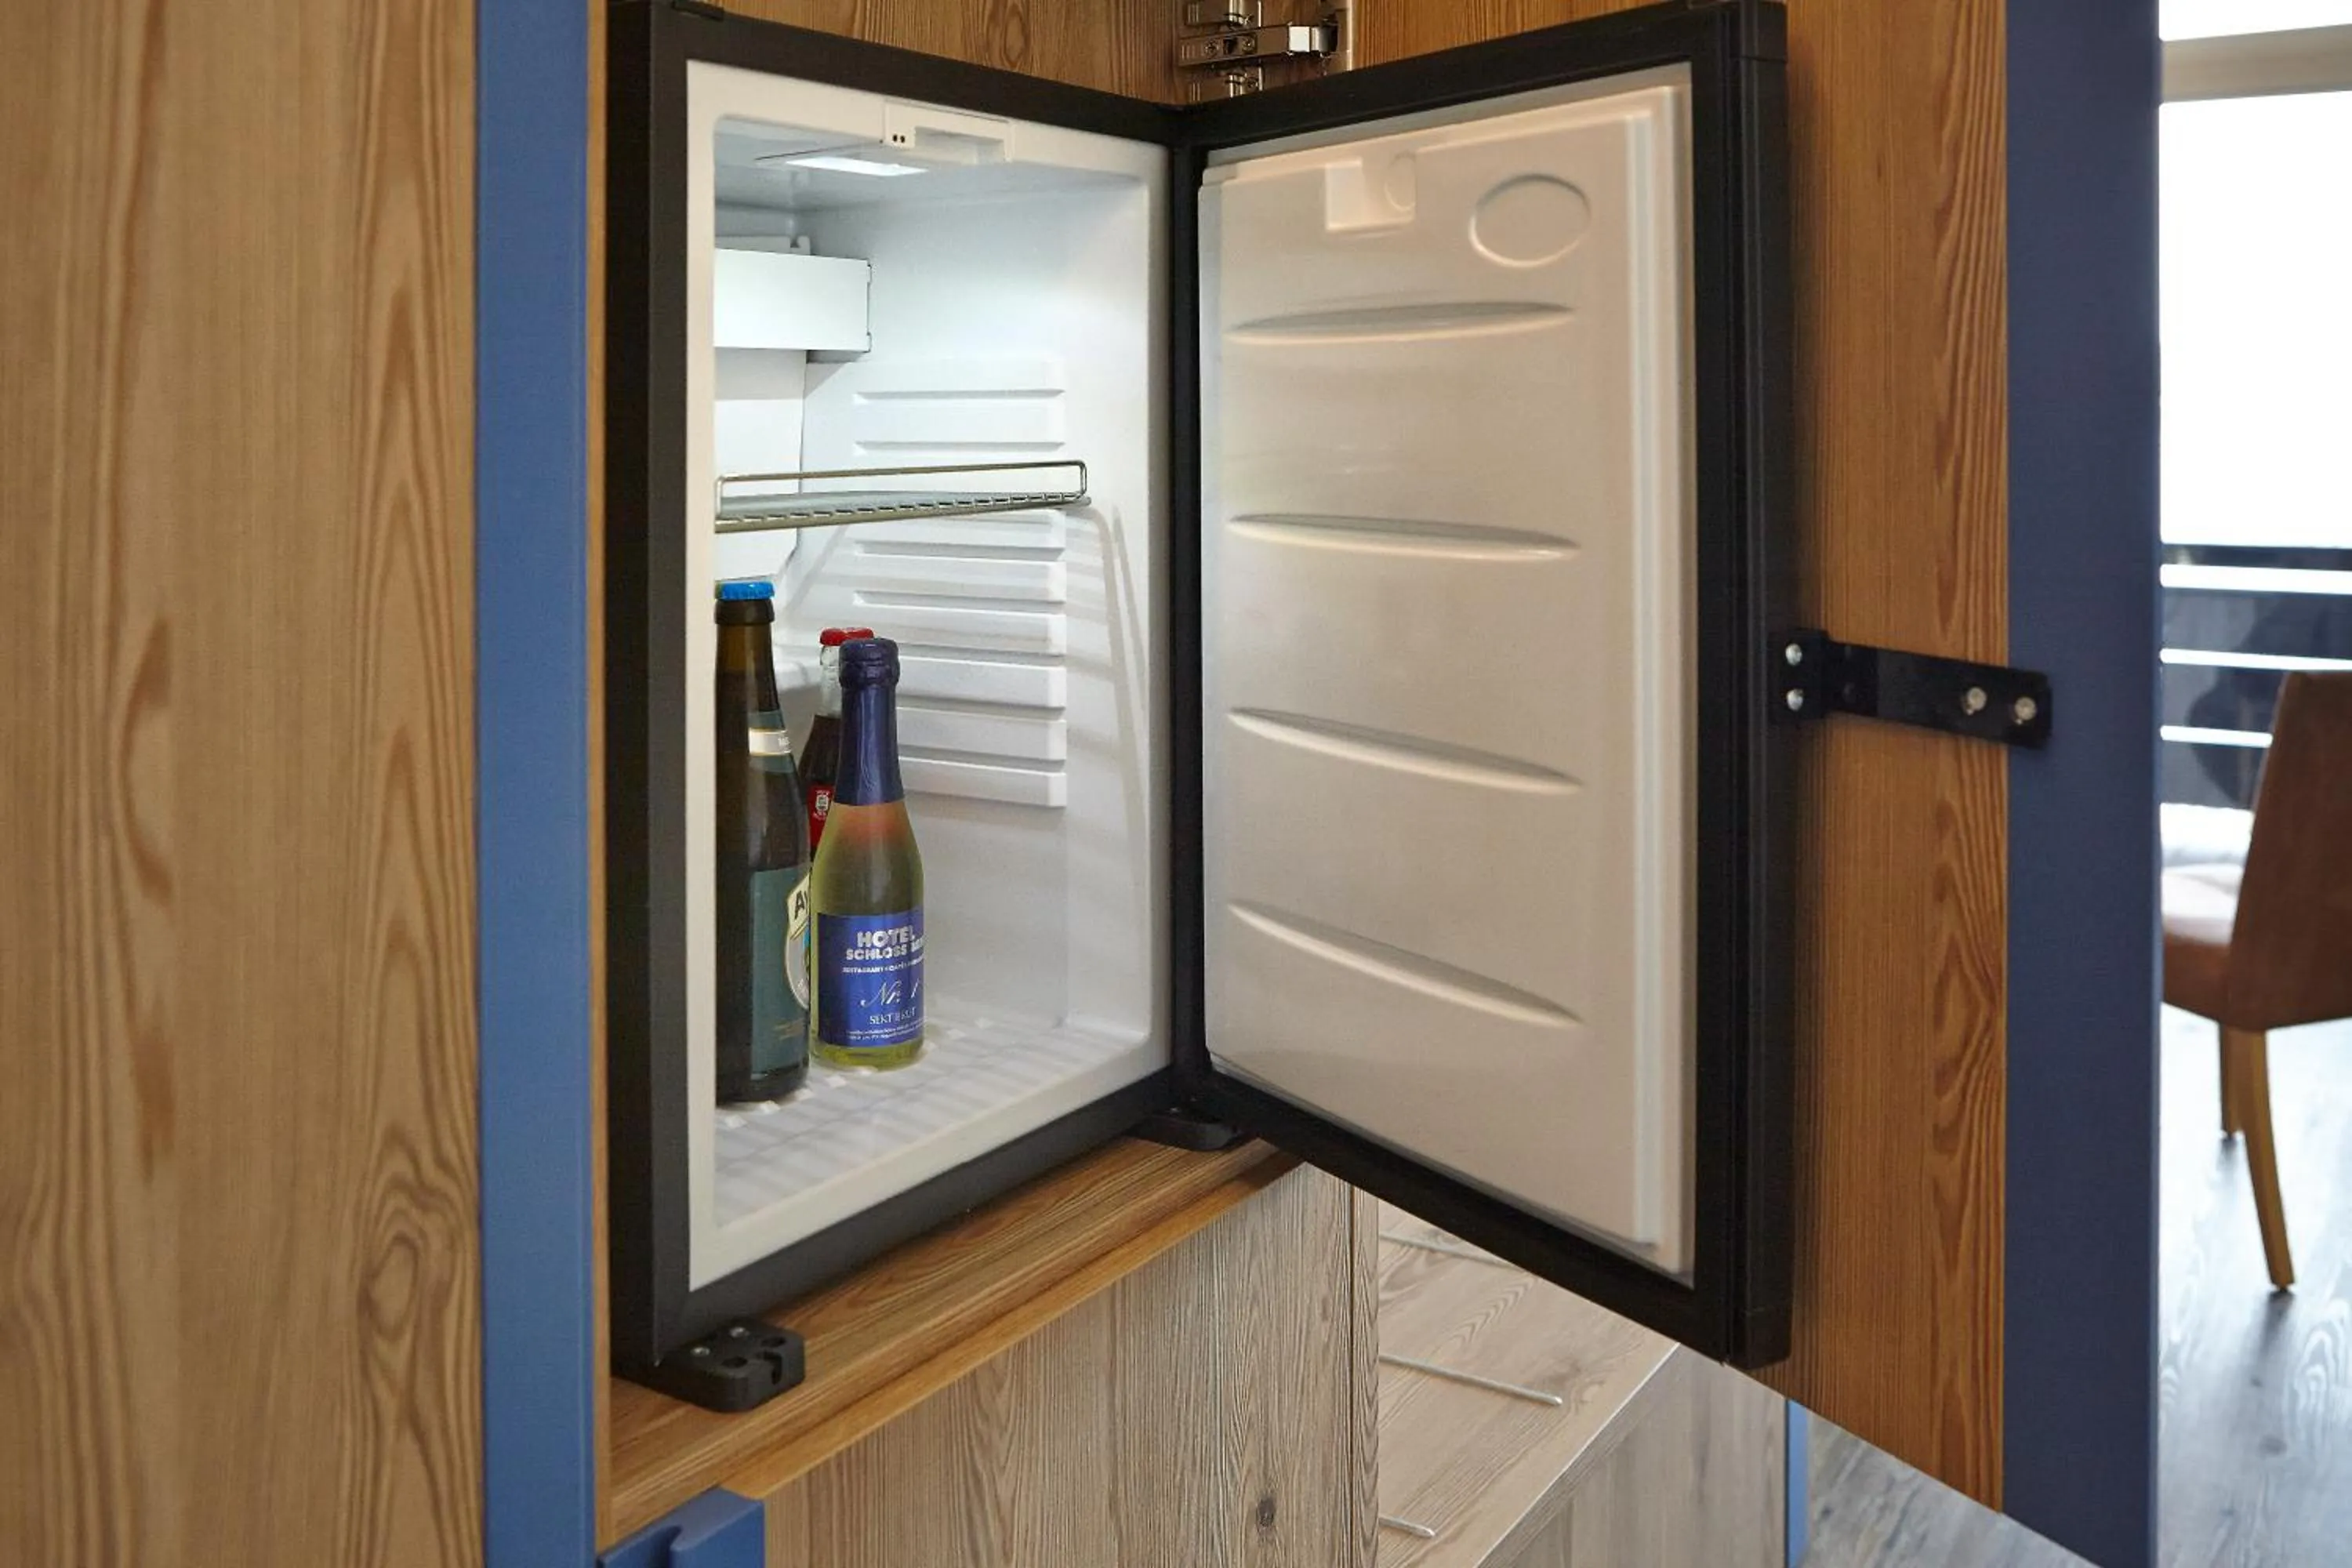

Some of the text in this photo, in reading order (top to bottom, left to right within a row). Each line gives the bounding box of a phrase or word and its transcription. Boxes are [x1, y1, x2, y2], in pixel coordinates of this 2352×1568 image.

[856, 925, 915, 948] HOTEL
[845, 943, 908, 960] SCHLOSS
[869, 1013, 892, 1025] SEKT
